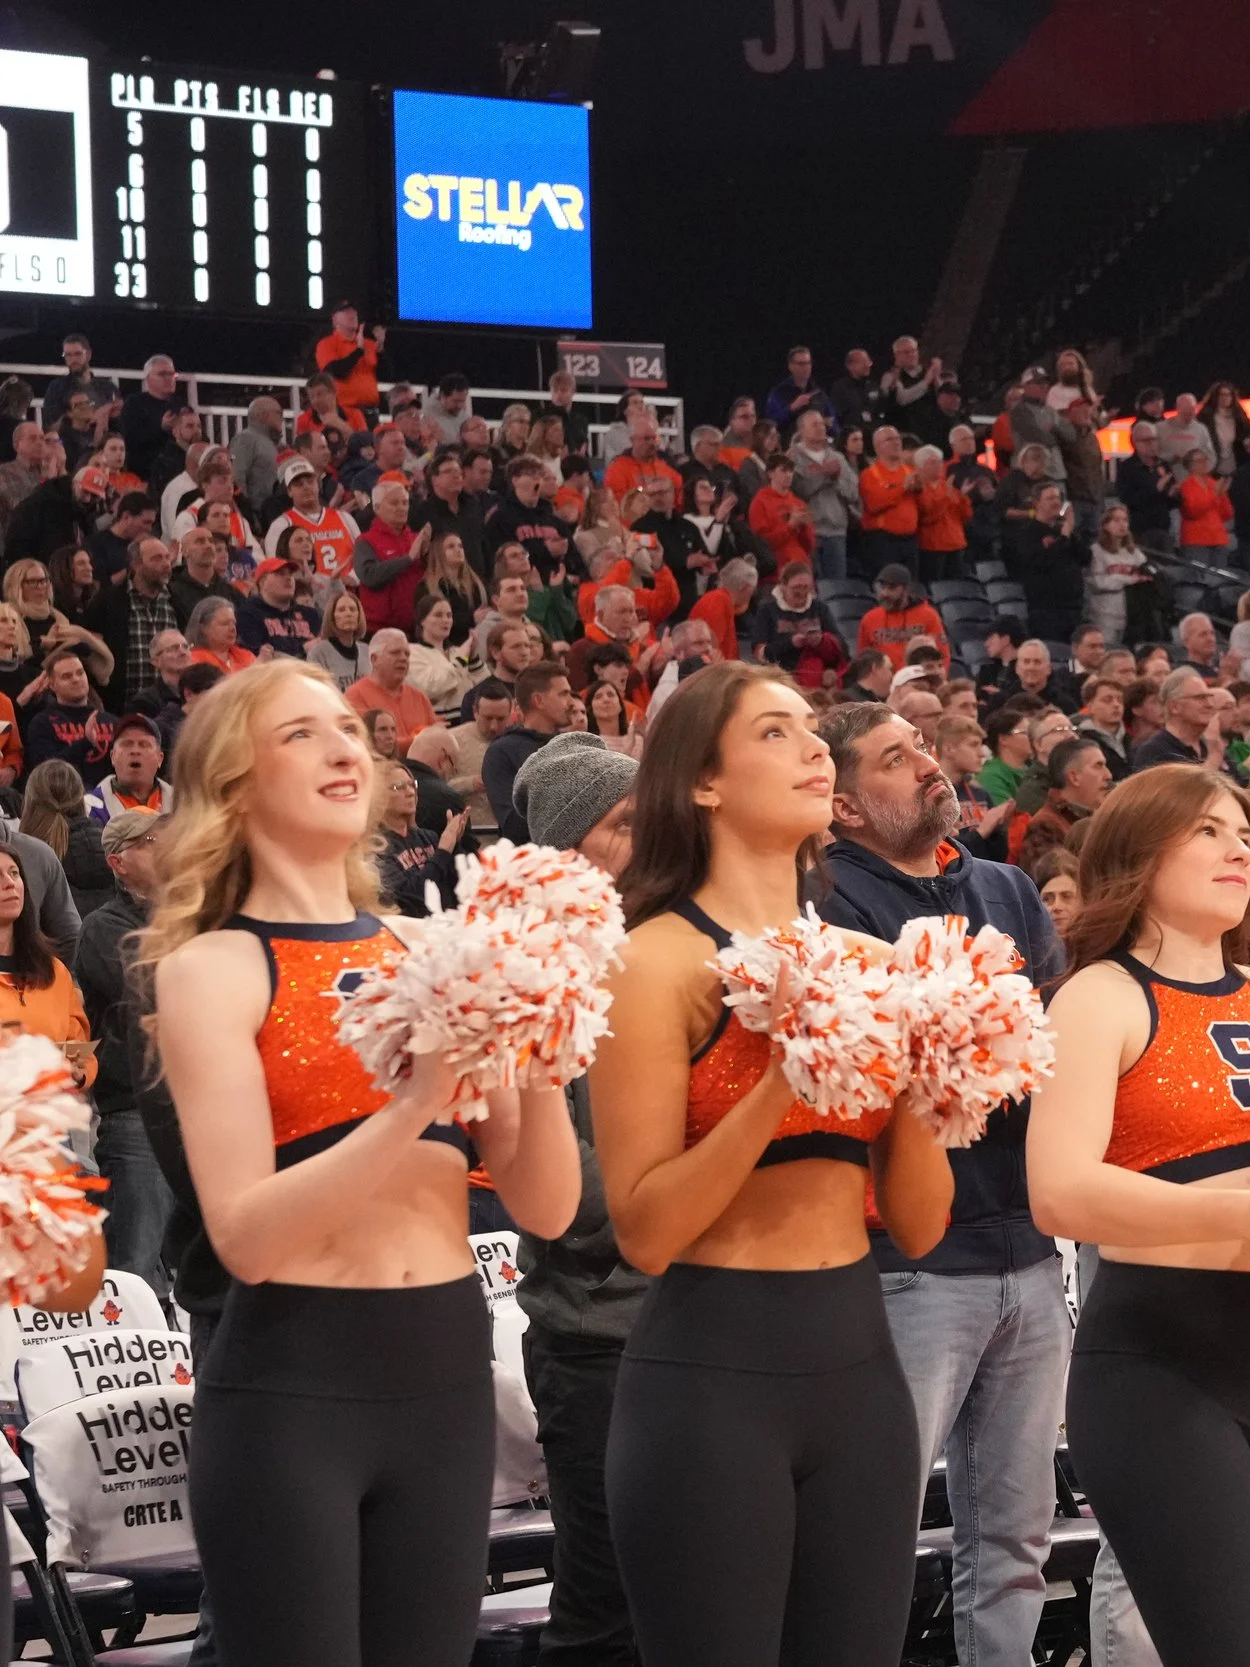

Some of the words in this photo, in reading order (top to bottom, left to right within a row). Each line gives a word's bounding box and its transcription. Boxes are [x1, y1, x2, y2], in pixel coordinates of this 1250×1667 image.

[742, 0, 955, 73] JMA
[174, 79, 218, 112] PTS
[239, 85, 280, 118] FLS
[128, 111, 143, 146] 5
[403, 173, 584, 231] STELLAR
[121, 224, 146, 260] 11
[458, 221, 532, 252] Roofing
[114, 261, 147, 298] 33
[563, 354, 600, 377] 123
[627, 357, 663, 380] 124
[13, 1307, 92, 1333] Level
[22, 1335, 49, 1346] SAFETY
[63, 1334, 190, 1370] Hidden
[75, 1363, 162, 1397] Level
[91, 1430, 189, 1476] Level
[102, 1480, 136, 1493] SAFETY
[138, 1473, 187, 1489] THROUGH
[124, 1501, 167, 1528] CRTE
[170, 1499, 183, 1521] A
